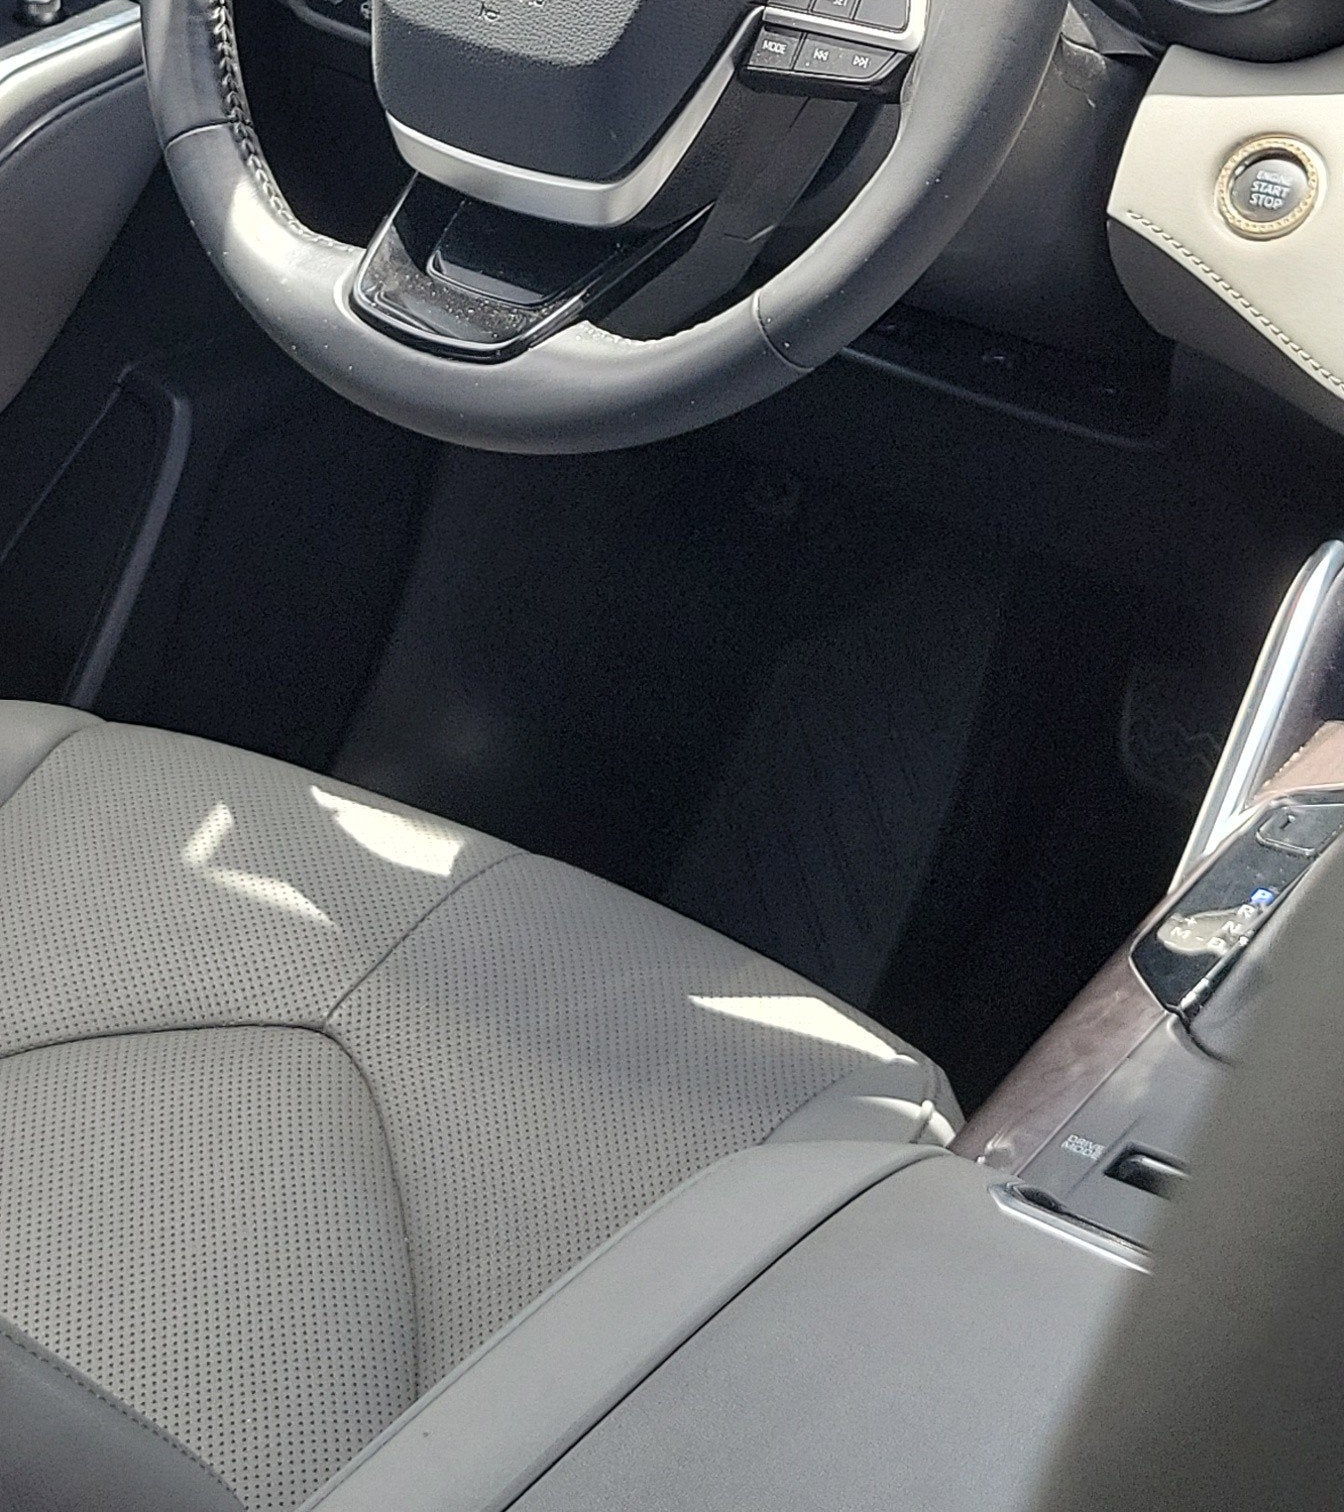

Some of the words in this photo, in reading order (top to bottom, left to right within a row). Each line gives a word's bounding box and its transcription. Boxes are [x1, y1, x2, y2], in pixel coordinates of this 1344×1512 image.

[762, 39, 788, 55] MODE
[1251, 179, 1292, 198] START
[1249, 192, 1283, 211] STOP
[1250, 887, 1276, 905] P
[1237, 903, 1257, 920] R
[1169, 925, 1193, 940] M
[1220, 919, 1244, 935] N
[1060, 1139, 1099, 1161] MODE
[1066, 1133, 1106, 1153] DRIVE
